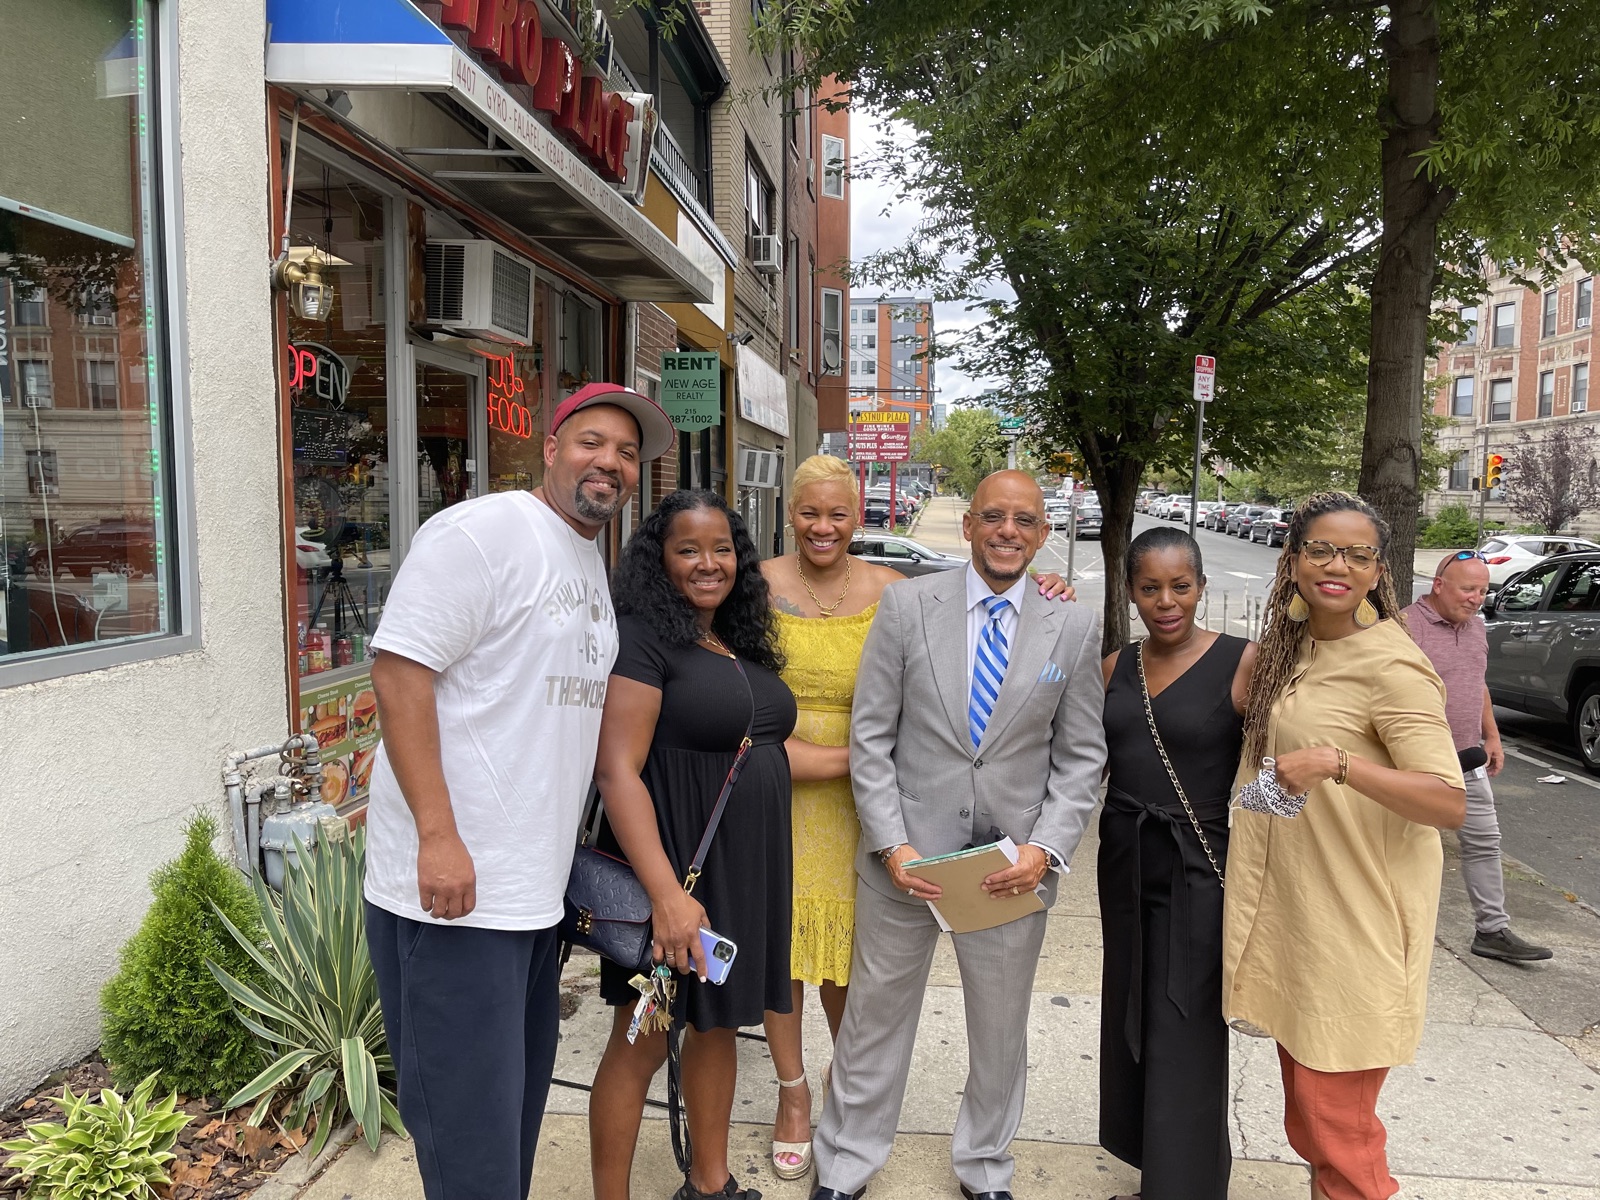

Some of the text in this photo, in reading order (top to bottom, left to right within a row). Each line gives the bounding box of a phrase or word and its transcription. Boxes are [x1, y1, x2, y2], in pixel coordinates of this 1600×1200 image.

[456, 58, 476, 96] 4407
[486, 85, 508, 122] GYRO
[513, 108, 541, 152] FALAFEL
[546, 137, 565, 172] KEBAB
[534, 38, 635, 184] PLACE
[664, 357, 716, 371] RENT
[664, 379, 717, 389] NEW AGE
[1198, 375, 1210, 383] ANY
[1197, 383, 1210, 391] TIME
[676, 392, 705, 400] REALTY
[487, 392, 532, 438] FOOD
[669, 415, 713, 424] 387-1002
[886, 412, 908, 422] PLAZA
[296, 415, 346, 442] ATM
[543, 578, 588, 628] PHILLY
